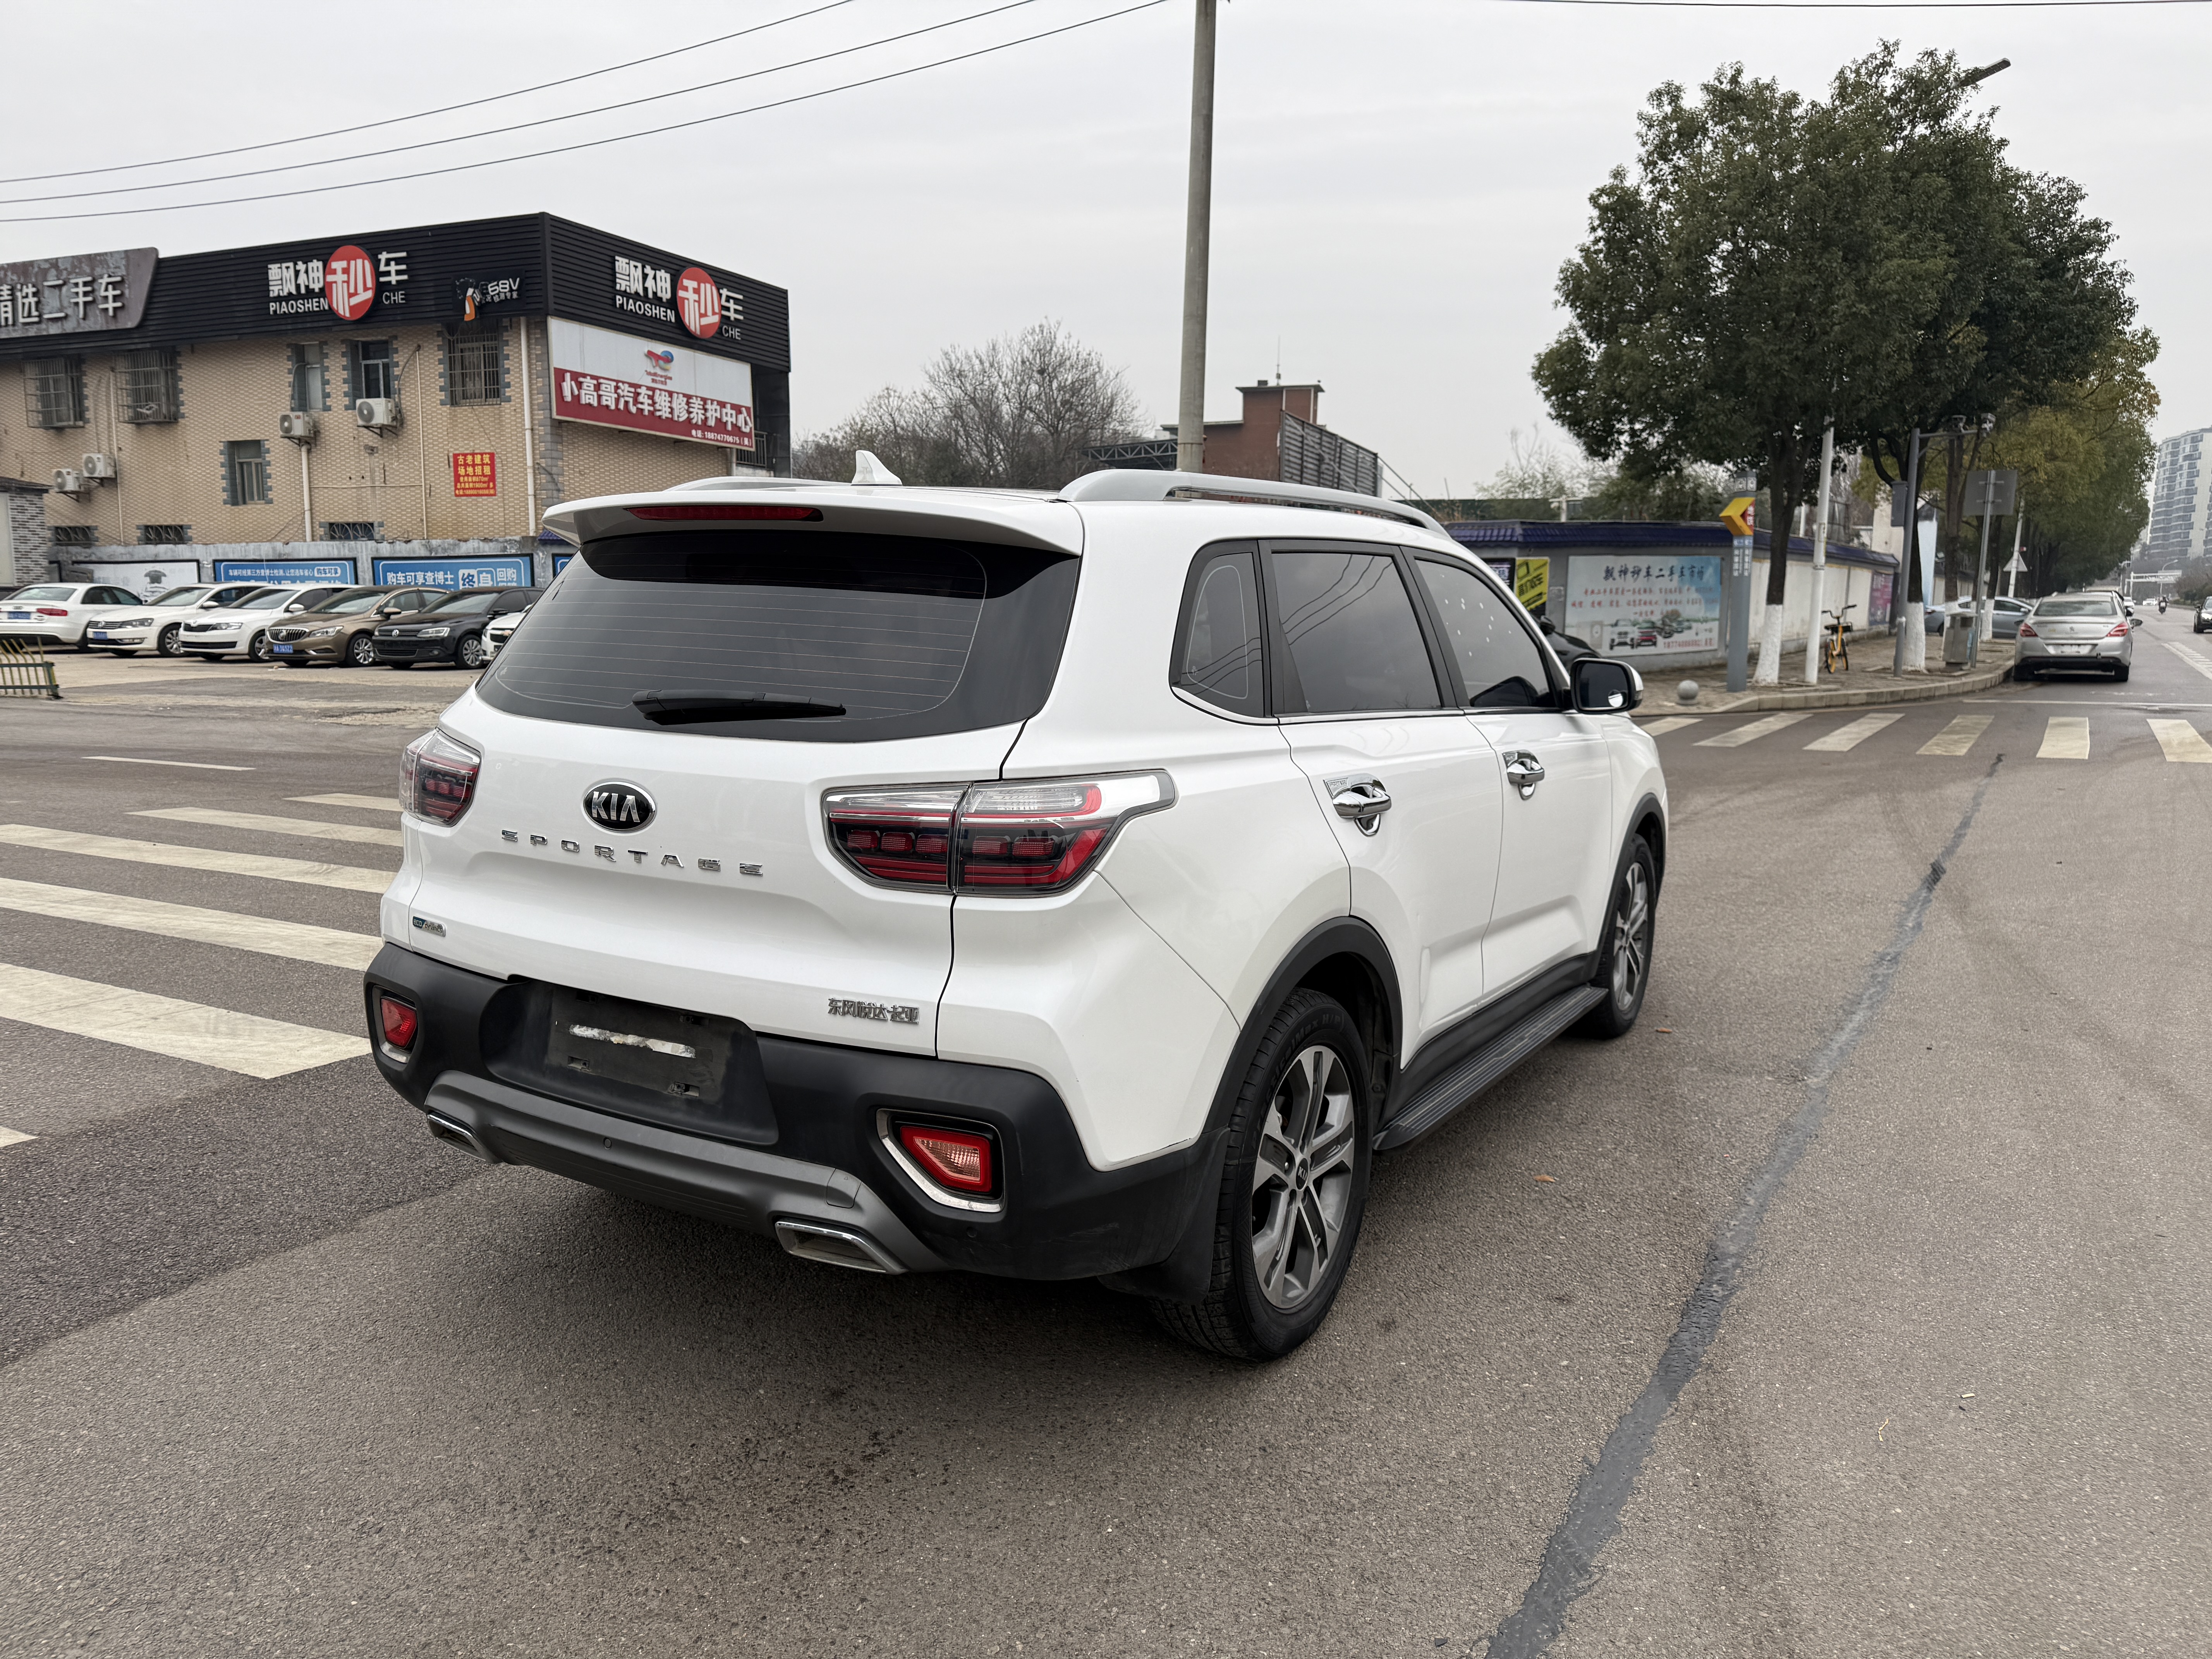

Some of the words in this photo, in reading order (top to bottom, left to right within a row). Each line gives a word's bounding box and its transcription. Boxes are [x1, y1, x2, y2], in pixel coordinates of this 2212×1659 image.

[269, 297, 330, 314] PIAOSHEN
[383, 291, 405, 304] CHE
[616, 295, 675, 323] PIAOSHEN
[722, 325, 741, 340] CHE
[561, 373, 752, 433] 小高哥汽车维修养护中心
[457, 454, 490, 465] 古老建筑
[458, 465, 491, 476] 场地招租
[316, 567, 339, 575] 购车可享
[387, 571, 454, 585] 购车可享查博士
[497, 568, 517, 581] 回购
[592, 791, 640, 823] KIA
[501, 829, 763, 877] SPORTAGE
[425, 922, 443, 933] dynamics
[828, 997, 920, 1025] 东风悦达起亚
